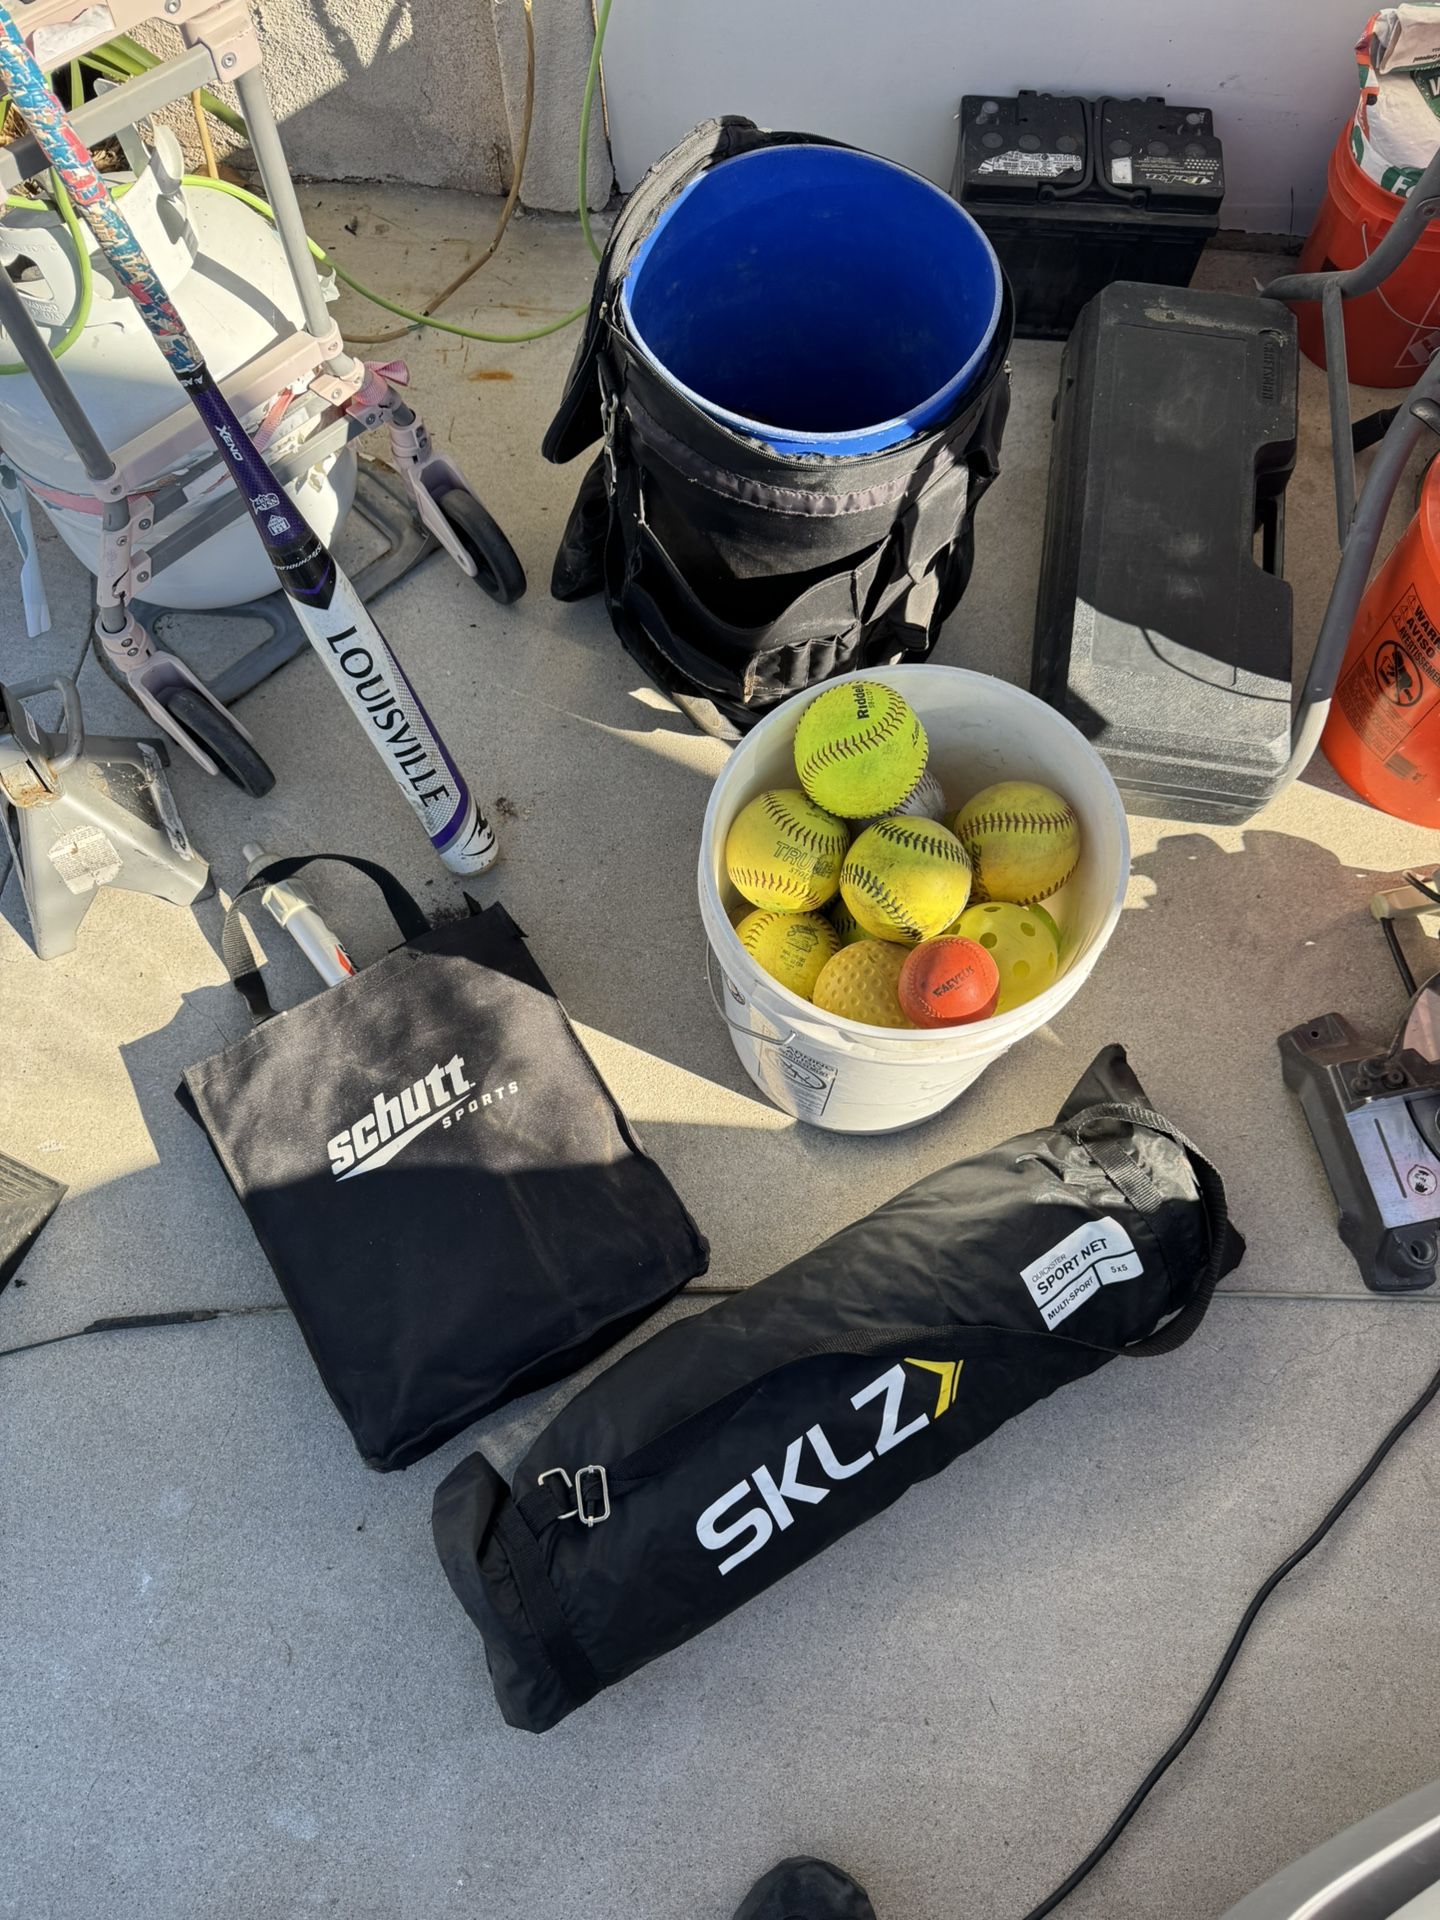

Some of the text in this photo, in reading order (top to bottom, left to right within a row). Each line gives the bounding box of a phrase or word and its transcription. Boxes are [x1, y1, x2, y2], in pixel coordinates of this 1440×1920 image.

[215, 424, 243, 461] XENO
[1406, 617, 1436, 660] AVISO
[327, 625, 451, 807] LOUISVILLE
[785, 1045, 836, 1072] ARNING
[327, 1054, 471, 1175] schutt
[442, 1081, 519, 1129] SPORTS
[1031, 1253, 1067, 1283] QUICKSTER
[1036, 1238, 1108, 1296] SPORT NET
[1110, 1264, 1128, 1274] 5x5
[1046, 1276, 1095, 1321] MULTI-SPORT
[695, 1363, 931, 1577] SKLZ
